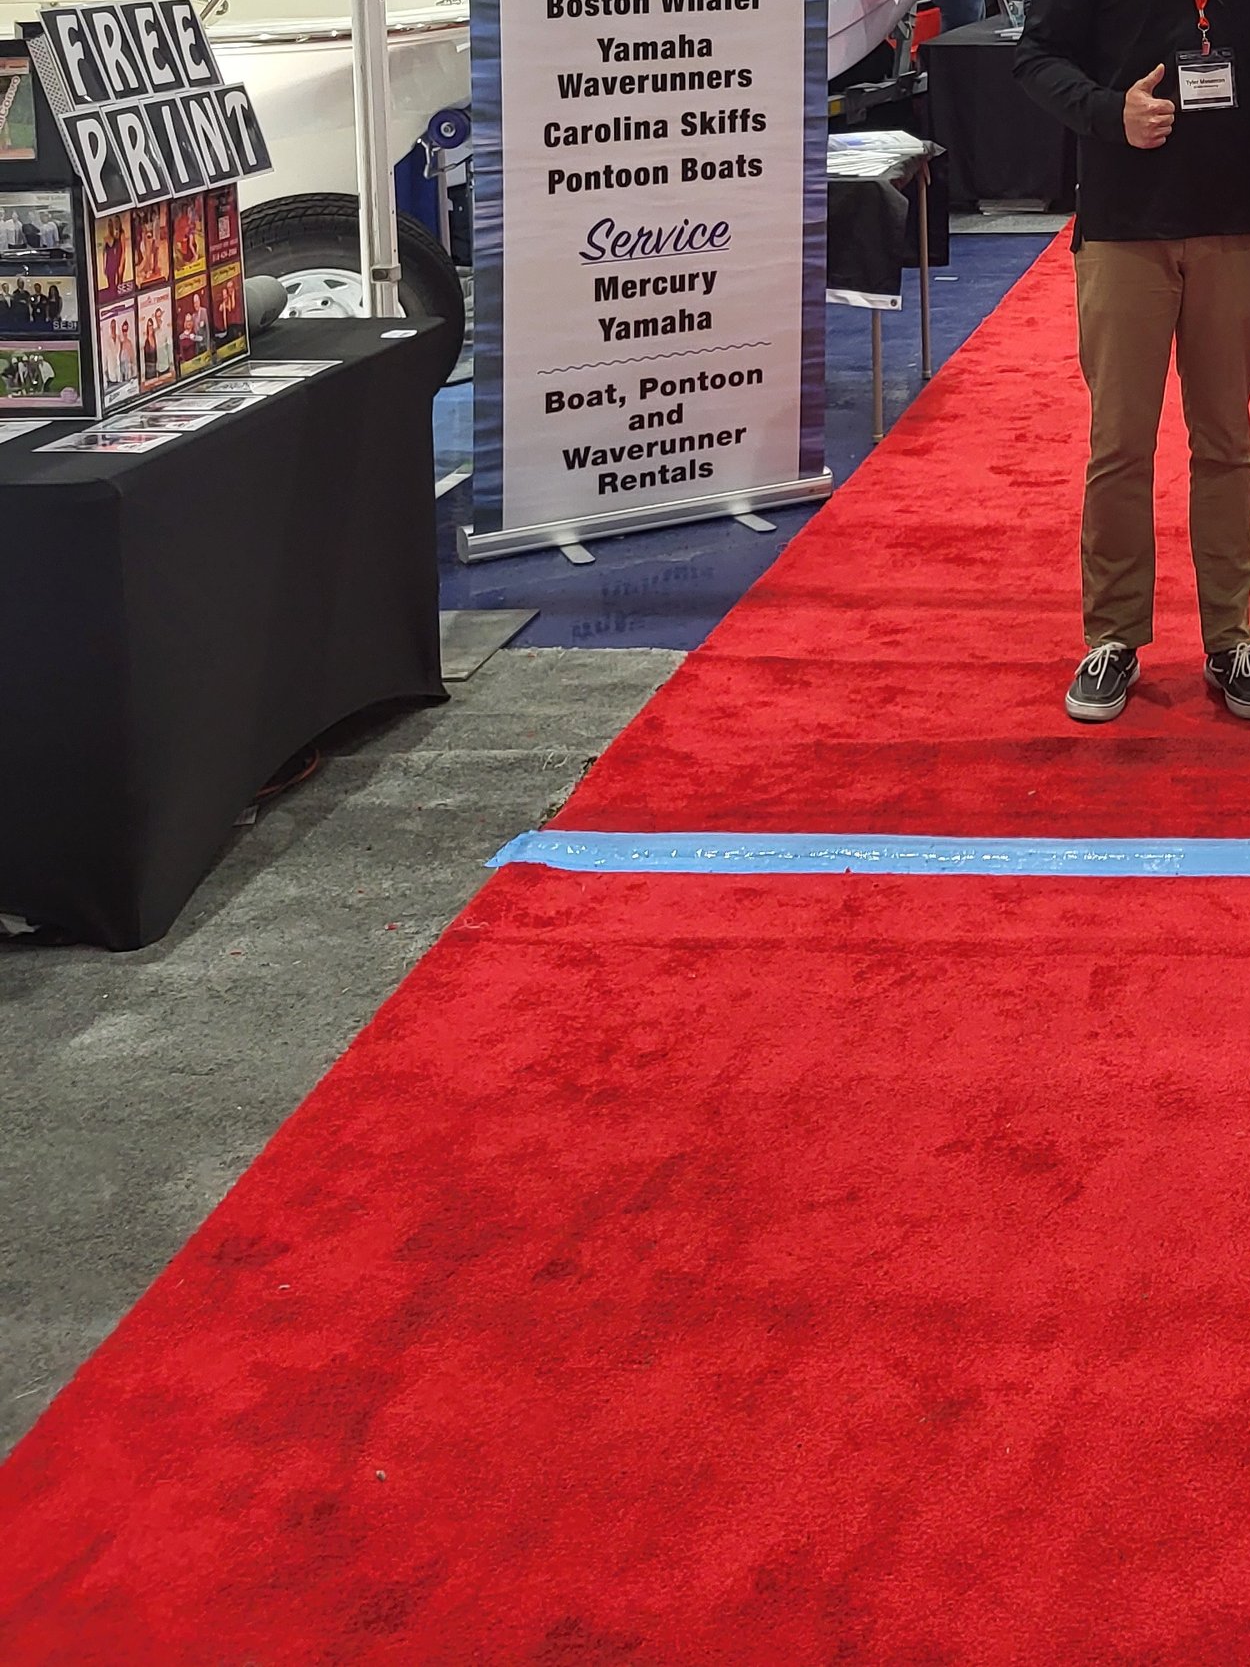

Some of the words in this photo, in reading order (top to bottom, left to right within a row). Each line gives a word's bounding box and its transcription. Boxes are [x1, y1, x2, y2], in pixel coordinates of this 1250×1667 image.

[56, 4, 211, 98] FREE
[597, 34, 713, 63] Yamaha
[558, 67, 752, 100] Waverunners
[81, 90, 265, 204] PRINT
[543, 117, 668, 148] Carolina
[681, 109, 767, 137] Skiffs
[548, 162, 669, 195] Pontoon
[681, 154, 763, 183] Boats
[579, 217, 732, 263] Service
[594, 270, 718, 303] Mercury
[598, 307, 712, 342] Yamaha
[545, 384, 628, 414] Boat,
[639, 365, 763, 401] Pontoon
[628, 403, 684, 432] and
[562, 424, 748, 471] Waverunner
[598, 458, 714, 495] Rentals
